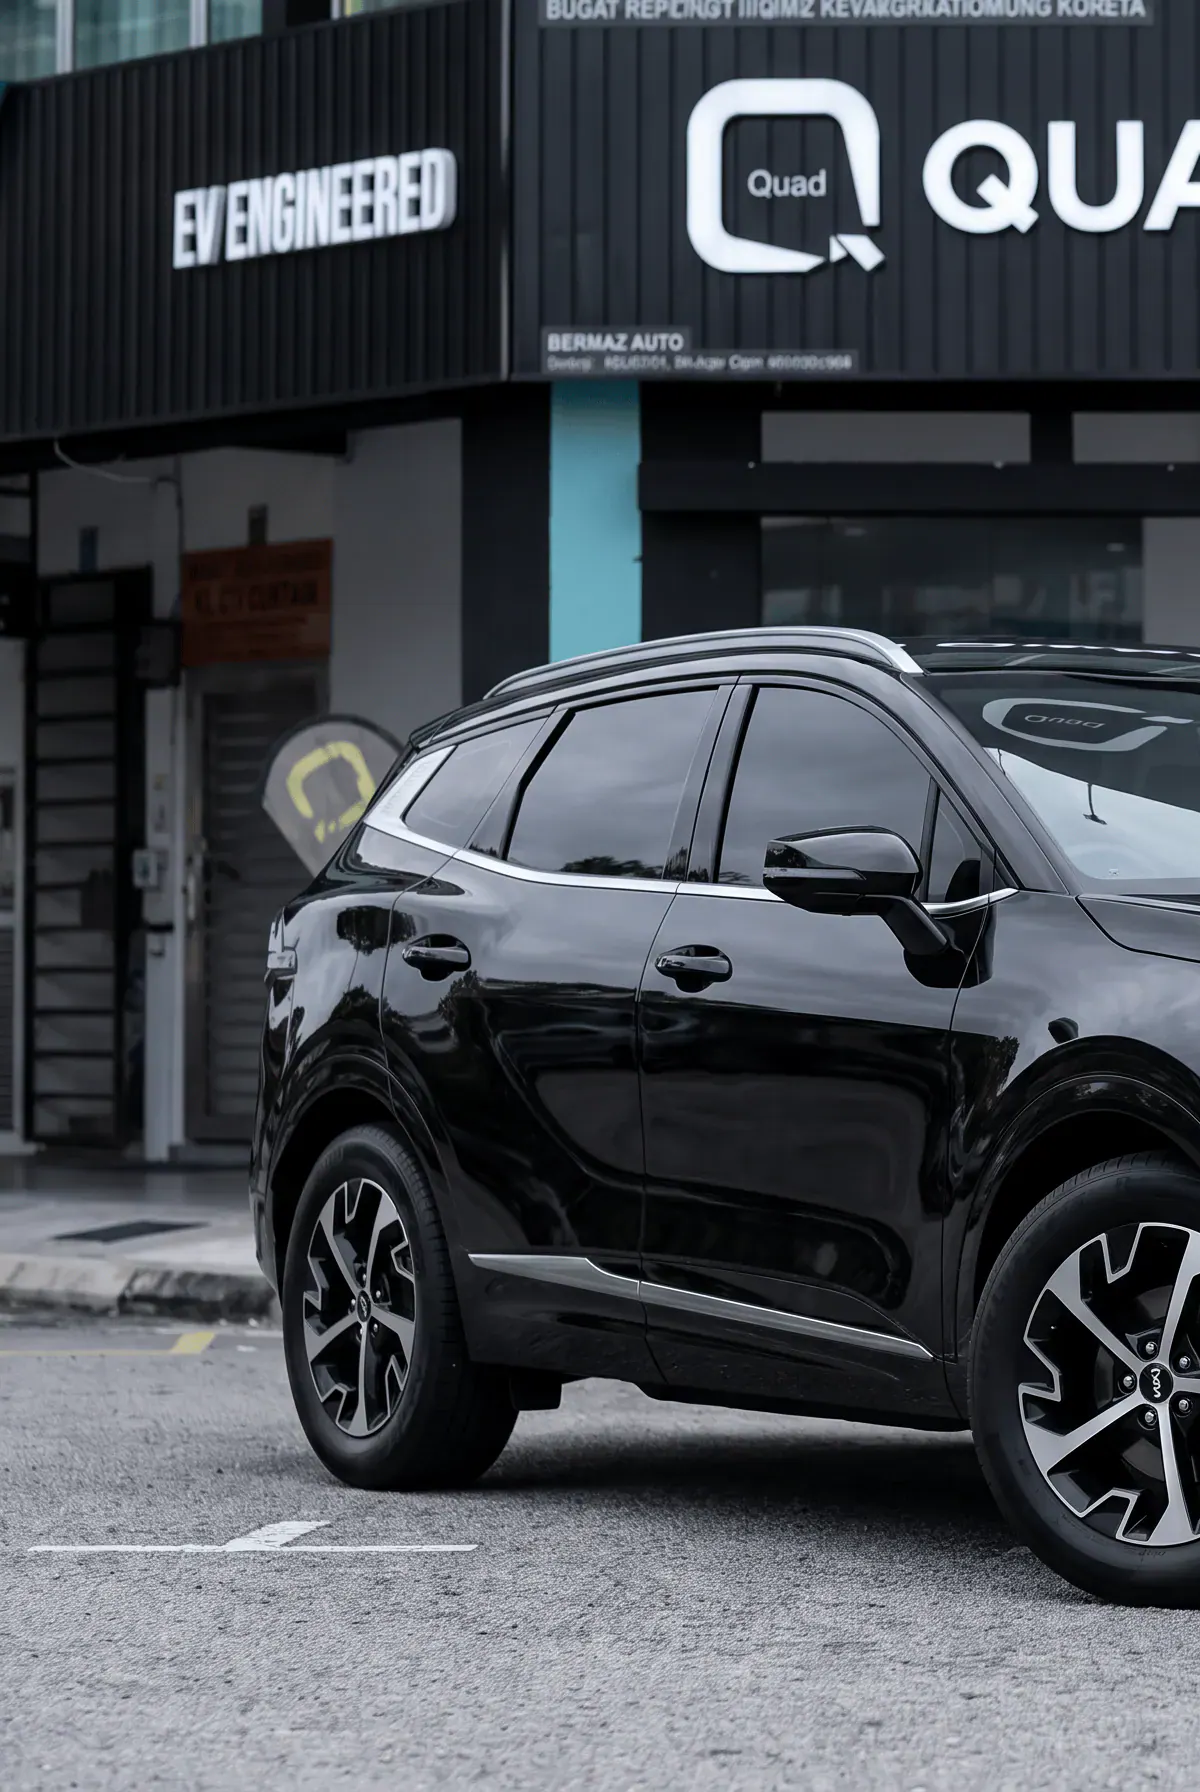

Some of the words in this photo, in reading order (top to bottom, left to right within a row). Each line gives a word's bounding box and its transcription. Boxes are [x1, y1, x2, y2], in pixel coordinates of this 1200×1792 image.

[747, 168, 827, 199] Quad
[173, 185, 227, 270] EV
[225, 147, 457, 262] ENGINEERED
[547, 332, 628, 352] BERMAZ
[629, 332, 685, 352] AUTO
